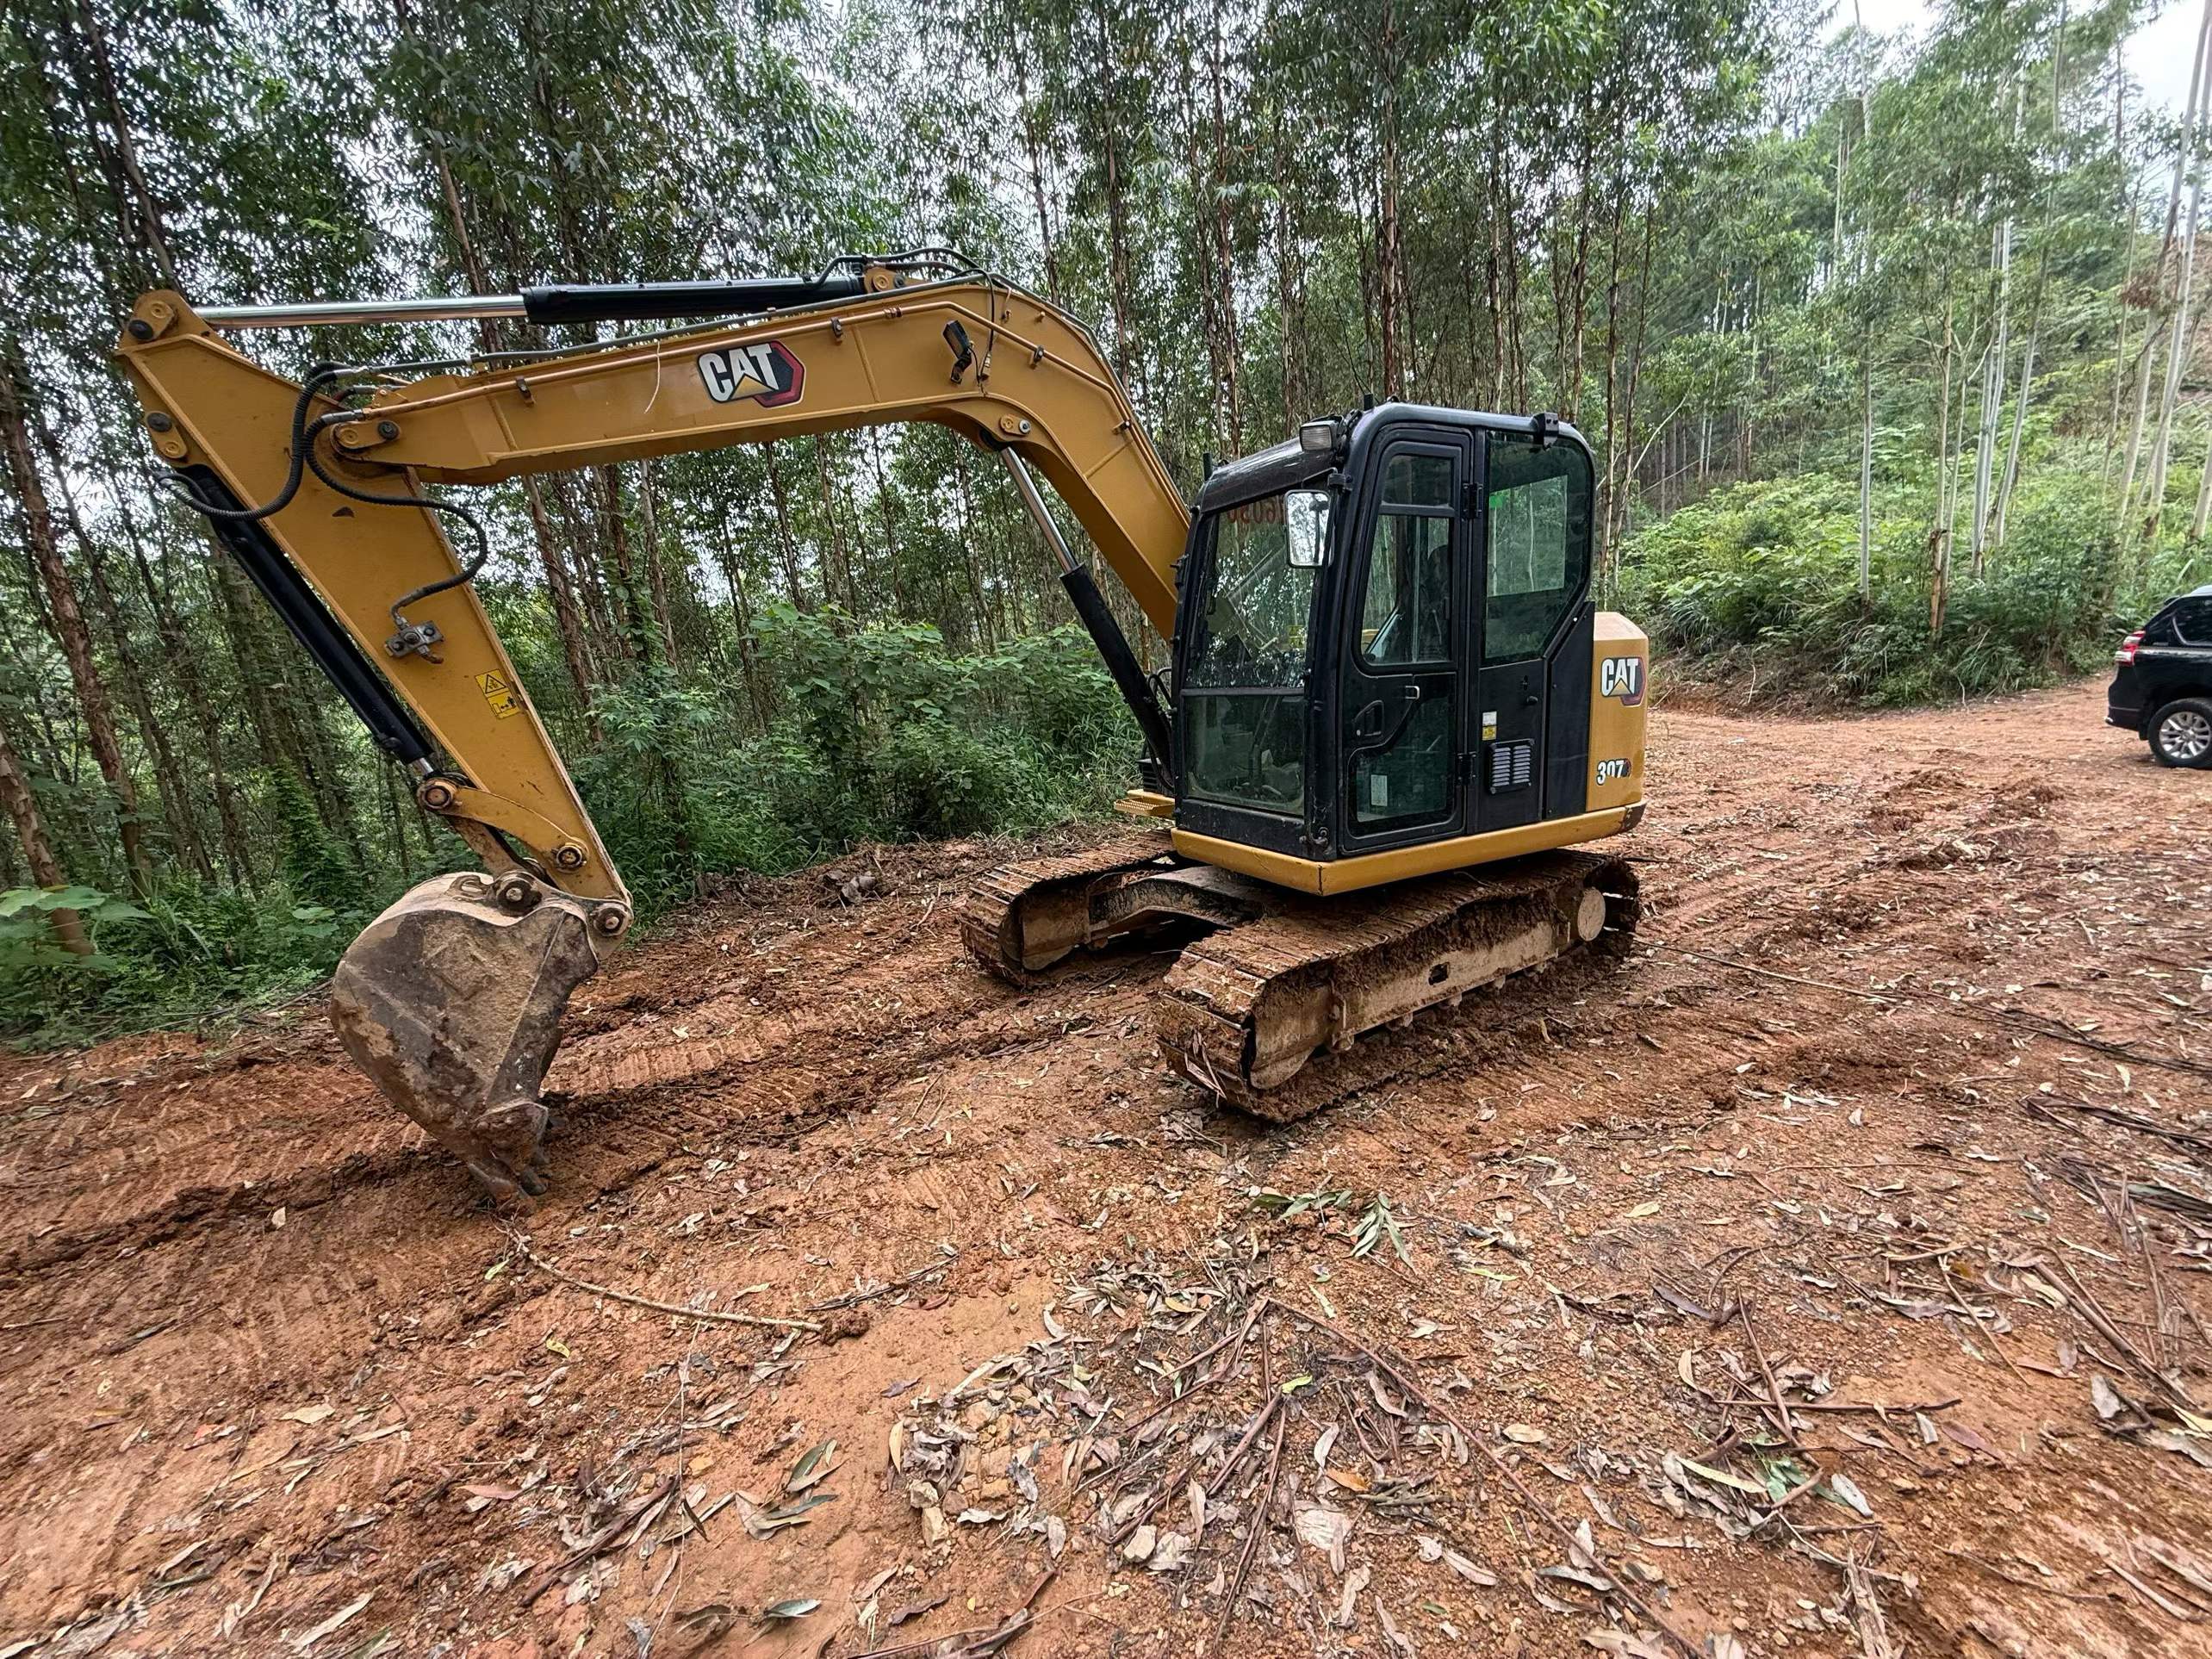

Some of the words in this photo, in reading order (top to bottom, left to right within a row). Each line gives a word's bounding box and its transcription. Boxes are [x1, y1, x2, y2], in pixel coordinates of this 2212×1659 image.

[699, 343, 780, 401] CAT
[1601, 658, 1639, 697] CAT
[1597, 760, 1625, 785] 307
